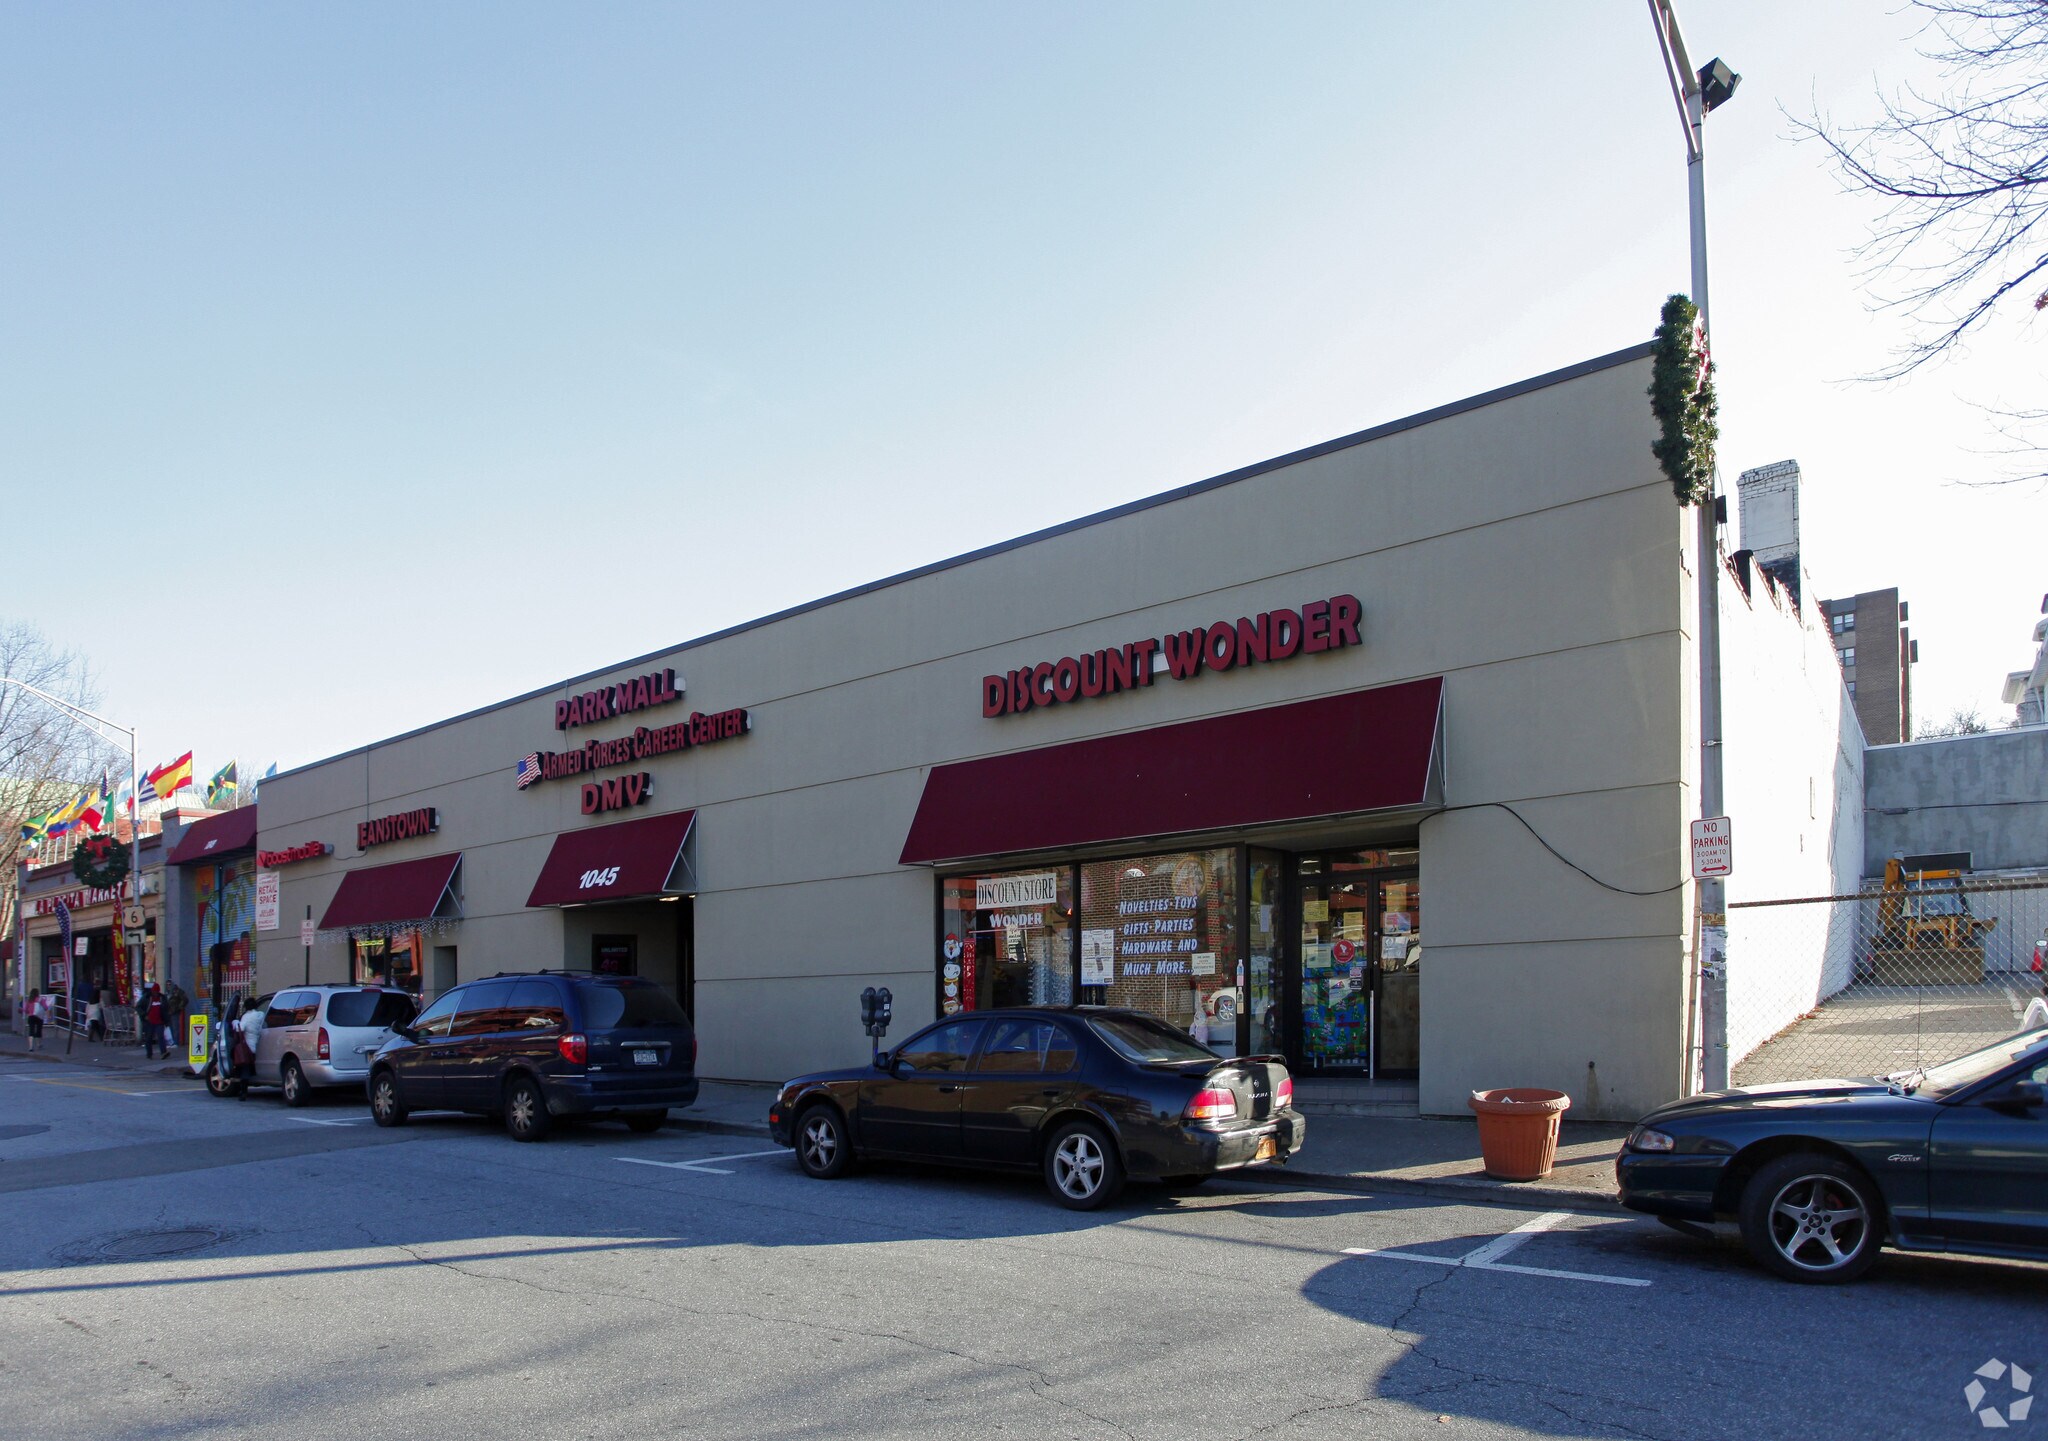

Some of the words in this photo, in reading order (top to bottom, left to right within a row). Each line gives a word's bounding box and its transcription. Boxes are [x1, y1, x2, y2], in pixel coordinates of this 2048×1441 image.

[982, 637, 1160, 719] DISCOUNT
[1164, 593, 1363, 680] WONDER
[555, 686, 615, 731] PARK
[615, 667, 684, 713] MALL
[542, 751, 586, 781] ARMED
[585, 738, 632, 770] FORCES
[633, 725, 689, 759] CAREER
[689, 707, 747, 746] CENTER
[581, 771, 650, 815] DMV
[1703, 822, 1718, 833] NO
[1693, 835, 1729, 849] PARKING
[579, 866, 620, 889] 1045
[258, 885, 278, 895] RETAIL
[978, 881, 1022, 905] DISCOUNT
[1024, 878, 1054, 901] STORE
[259, 894, 277, 904] SPACE
[1119, 898, 1169, 915] NOVELTIES
[1174, 895, 1198, 910] TOYS
[131, 911, 138, 923] 6
[989, 912, 1043, 928] WONDER
[1123, 922, 1149, 935] GIFTS
[1154, 918, 1194, 933] PARTIES
[1121, 939, 1173, 955] HARDWARE
[1177, 938, 1198, 951] AND
[1122, 961, 1152, 976] MUCH
